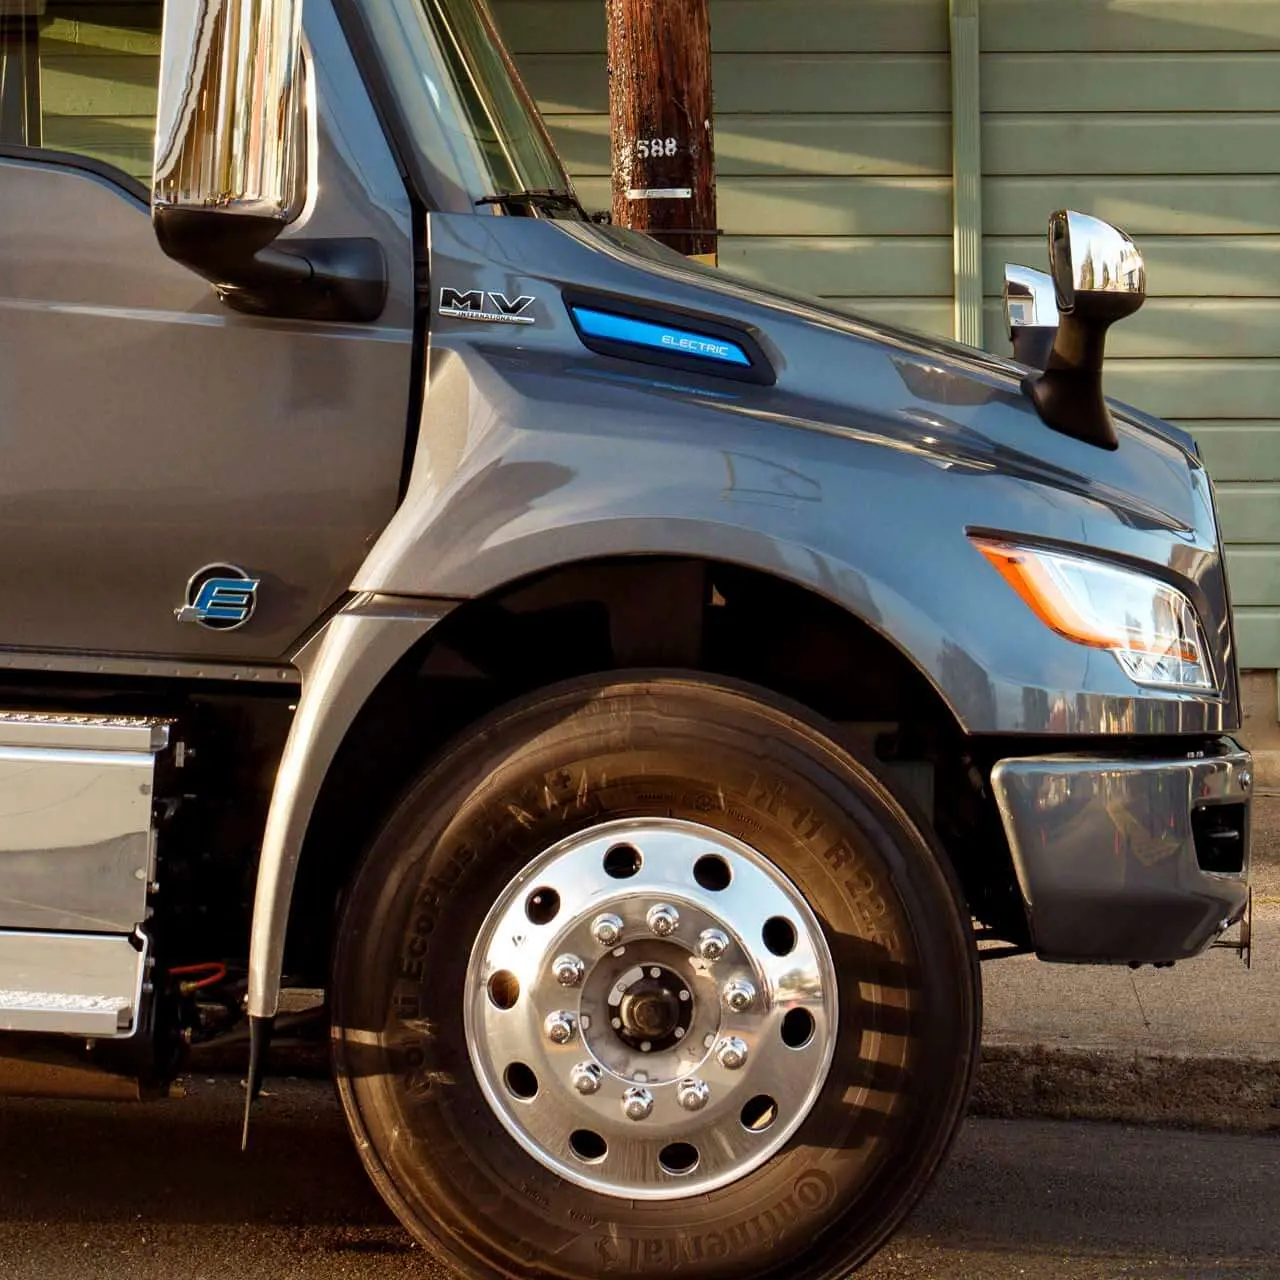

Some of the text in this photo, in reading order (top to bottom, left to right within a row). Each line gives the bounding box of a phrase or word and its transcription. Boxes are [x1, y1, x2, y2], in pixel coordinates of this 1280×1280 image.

[636, 137, 678, 159] 588
[439, 286, 536, 315] MV
[661, 334, 730, 357] ELECTRIC
